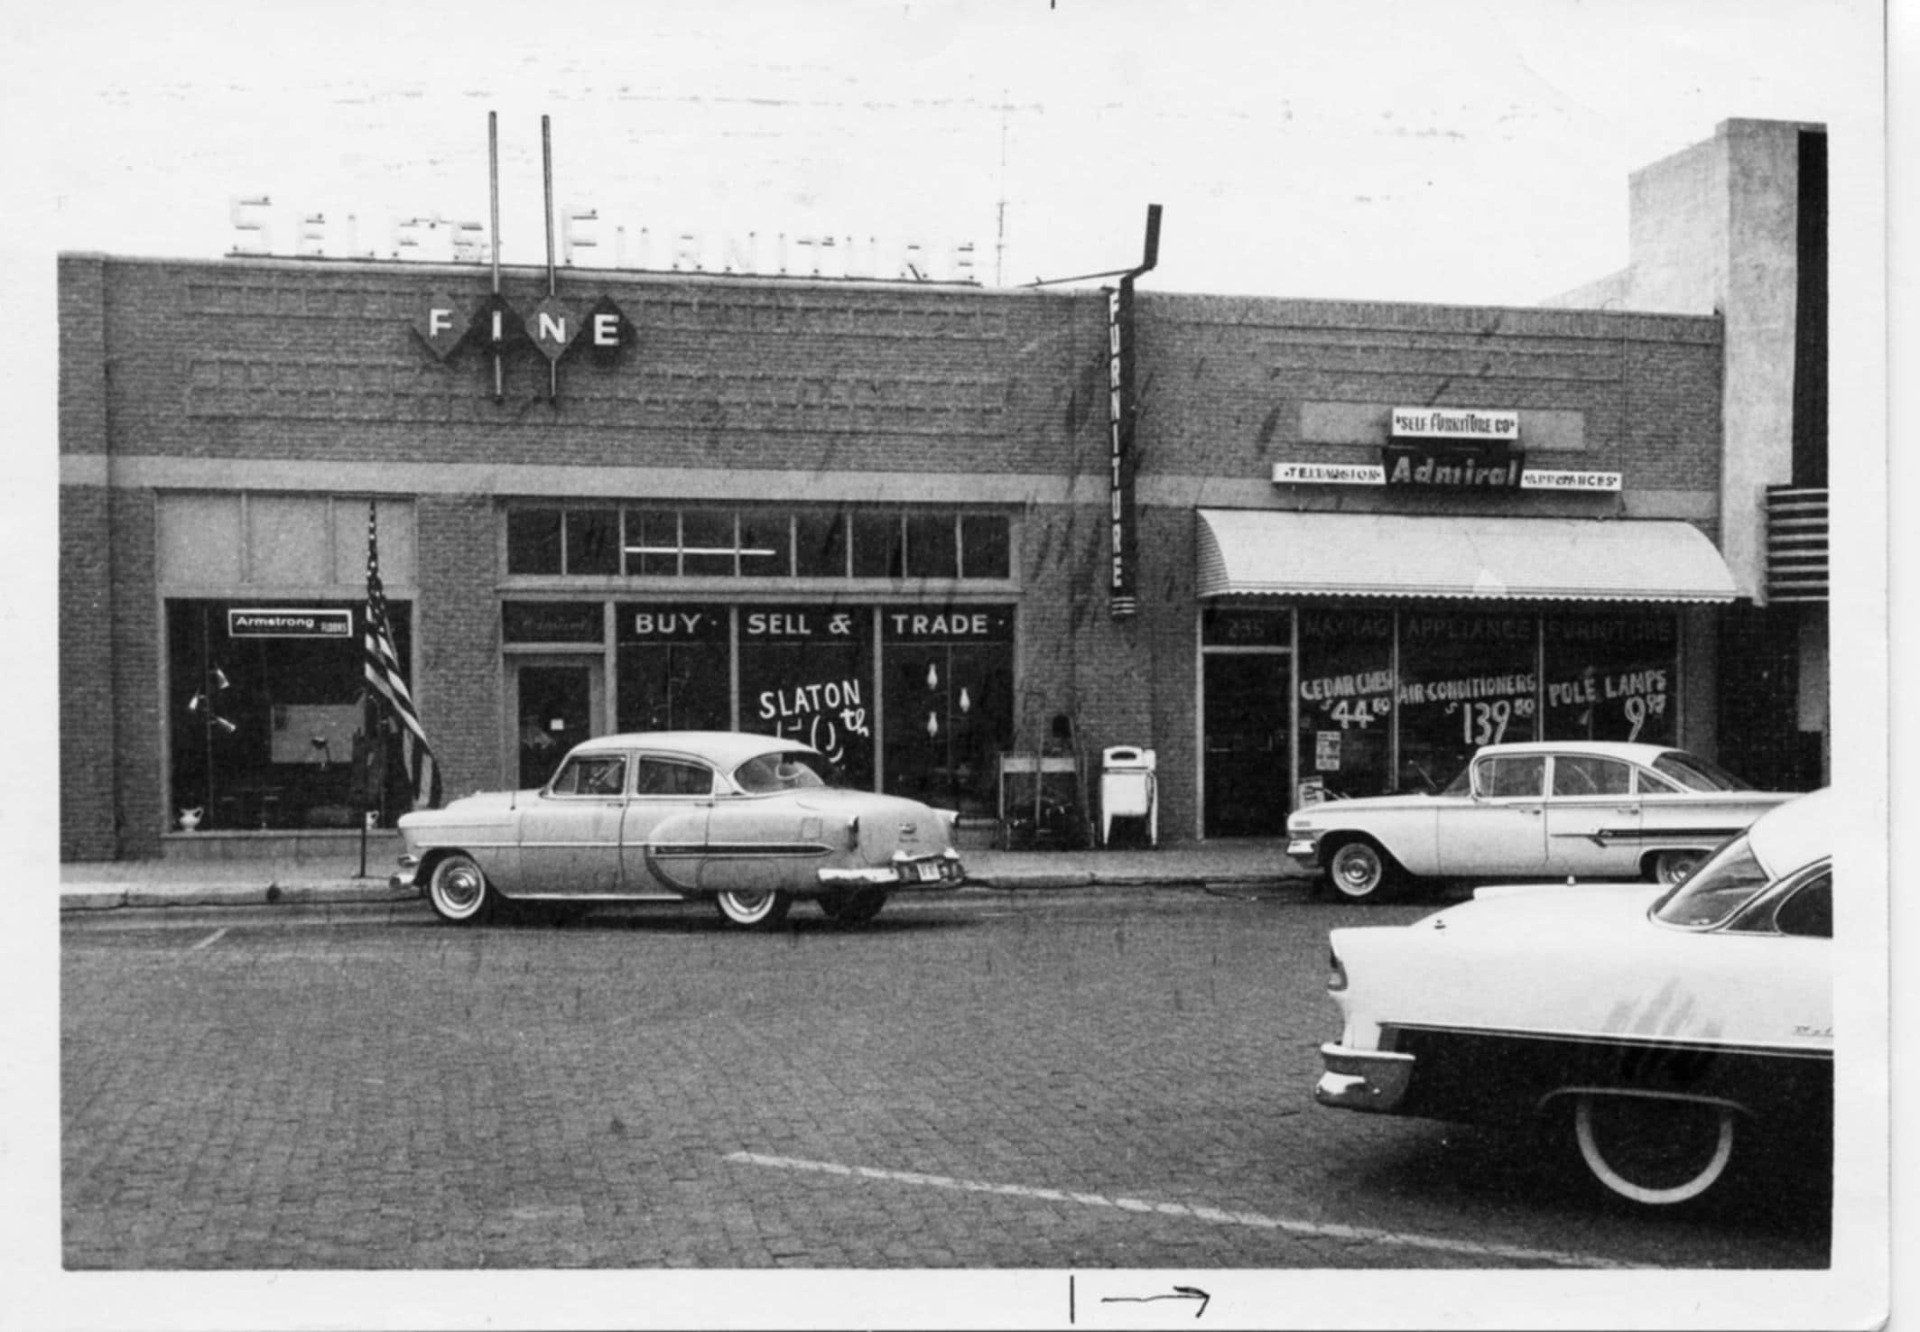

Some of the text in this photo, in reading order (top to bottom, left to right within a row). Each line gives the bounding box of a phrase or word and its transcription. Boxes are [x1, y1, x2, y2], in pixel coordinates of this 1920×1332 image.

[429, 309, 620, 346] FINE
[1401, 415, 1426, 432] SELF
[1109, 290, 1123, 588] FURNITURE
[1391, 456, 1517, 486] Admiral
[236, 616, 315, 629] Armstrong
[635, 613, 989, 635] BUY SELL & TRADE
[760, 679, 860, 719] SLATON
[1300, 675, 1356, 700] CEDAR
[1550, 670, 1666, 707] POLE LAMPS
